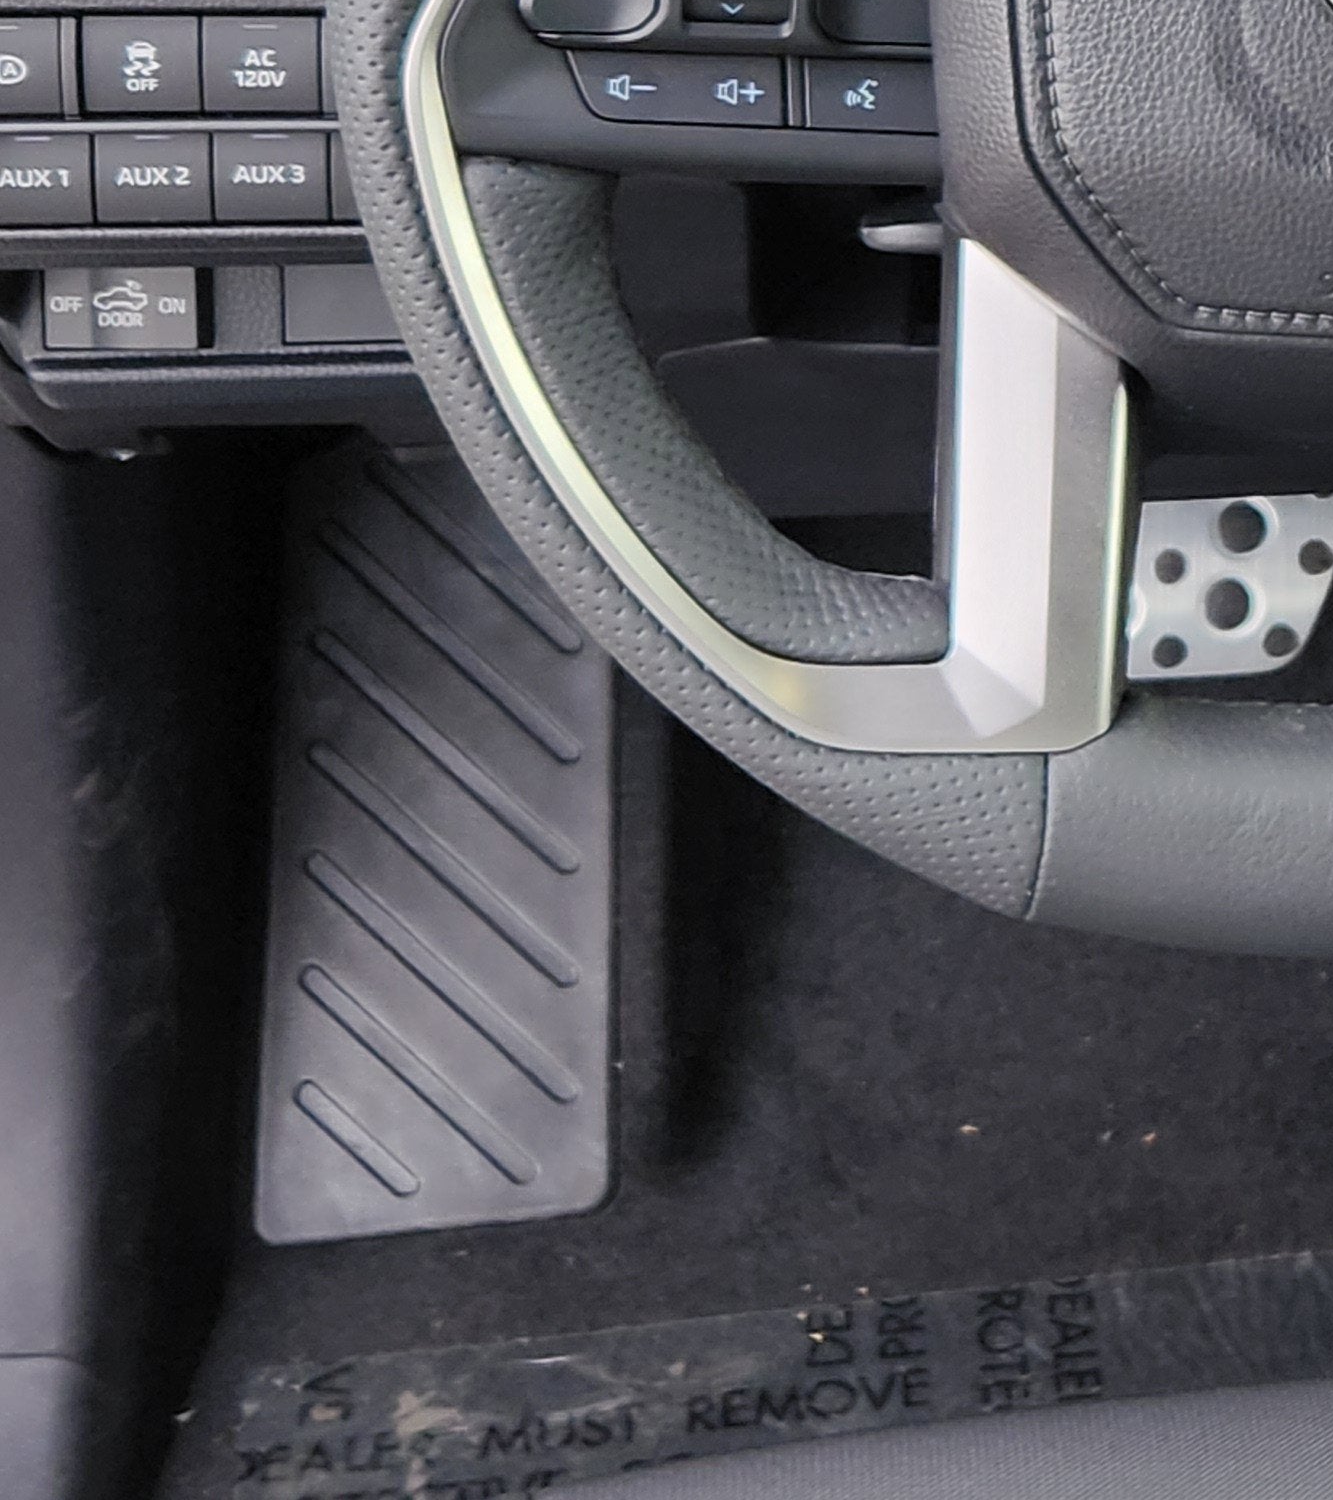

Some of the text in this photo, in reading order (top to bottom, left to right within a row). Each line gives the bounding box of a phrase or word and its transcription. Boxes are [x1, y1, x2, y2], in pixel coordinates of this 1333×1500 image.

[244, 49, 277, 68] AC
[126, 76, 159, 92] OFF
[233, 69, 286, 89] 120V
[0, 167, 71, 188] AUX 1
[116, 166, 192, 187] AUX 2
[232, 164, 306, 185] AUX 3
[50, 297, 82, 313] OFF
[158, 296, 186, 315] ON
[97, 312, 145, 329] DOOR
[479, 1409, 640, 1460] MUST
[687, 1368, 931, 1434] REMOVE
